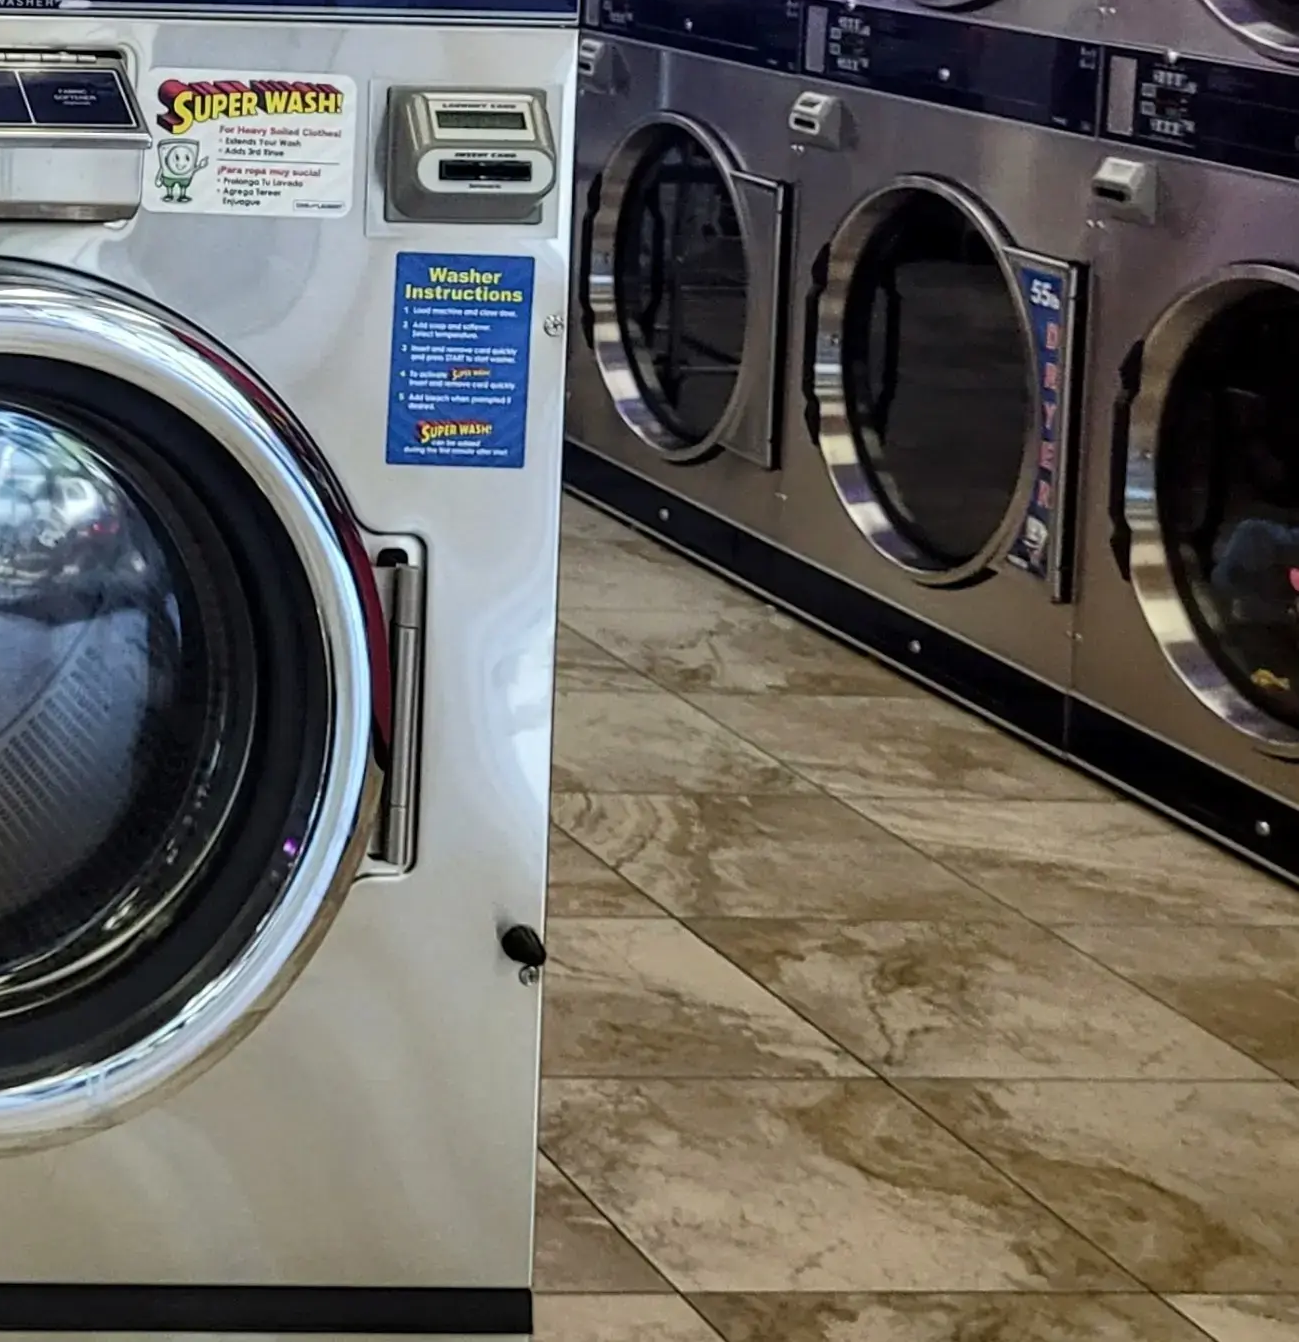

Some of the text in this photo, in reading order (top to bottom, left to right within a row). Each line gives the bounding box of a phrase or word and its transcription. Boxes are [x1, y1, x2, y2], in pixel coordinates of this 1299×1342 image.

[165, 86, 344, 135] SUPER WASH!
[219, 125, 342, 138] For Heavy Soiled Clothes!
[225, 137, 302, 147] Extends Your Wash
[224, 147, 246, 156] Adds
[269, 168, 291, 178] muy
[428, 266, 503, 285] Washer
[405, 283, 524, 303] Instructions
[419, 422, 457, 444] SUPER
